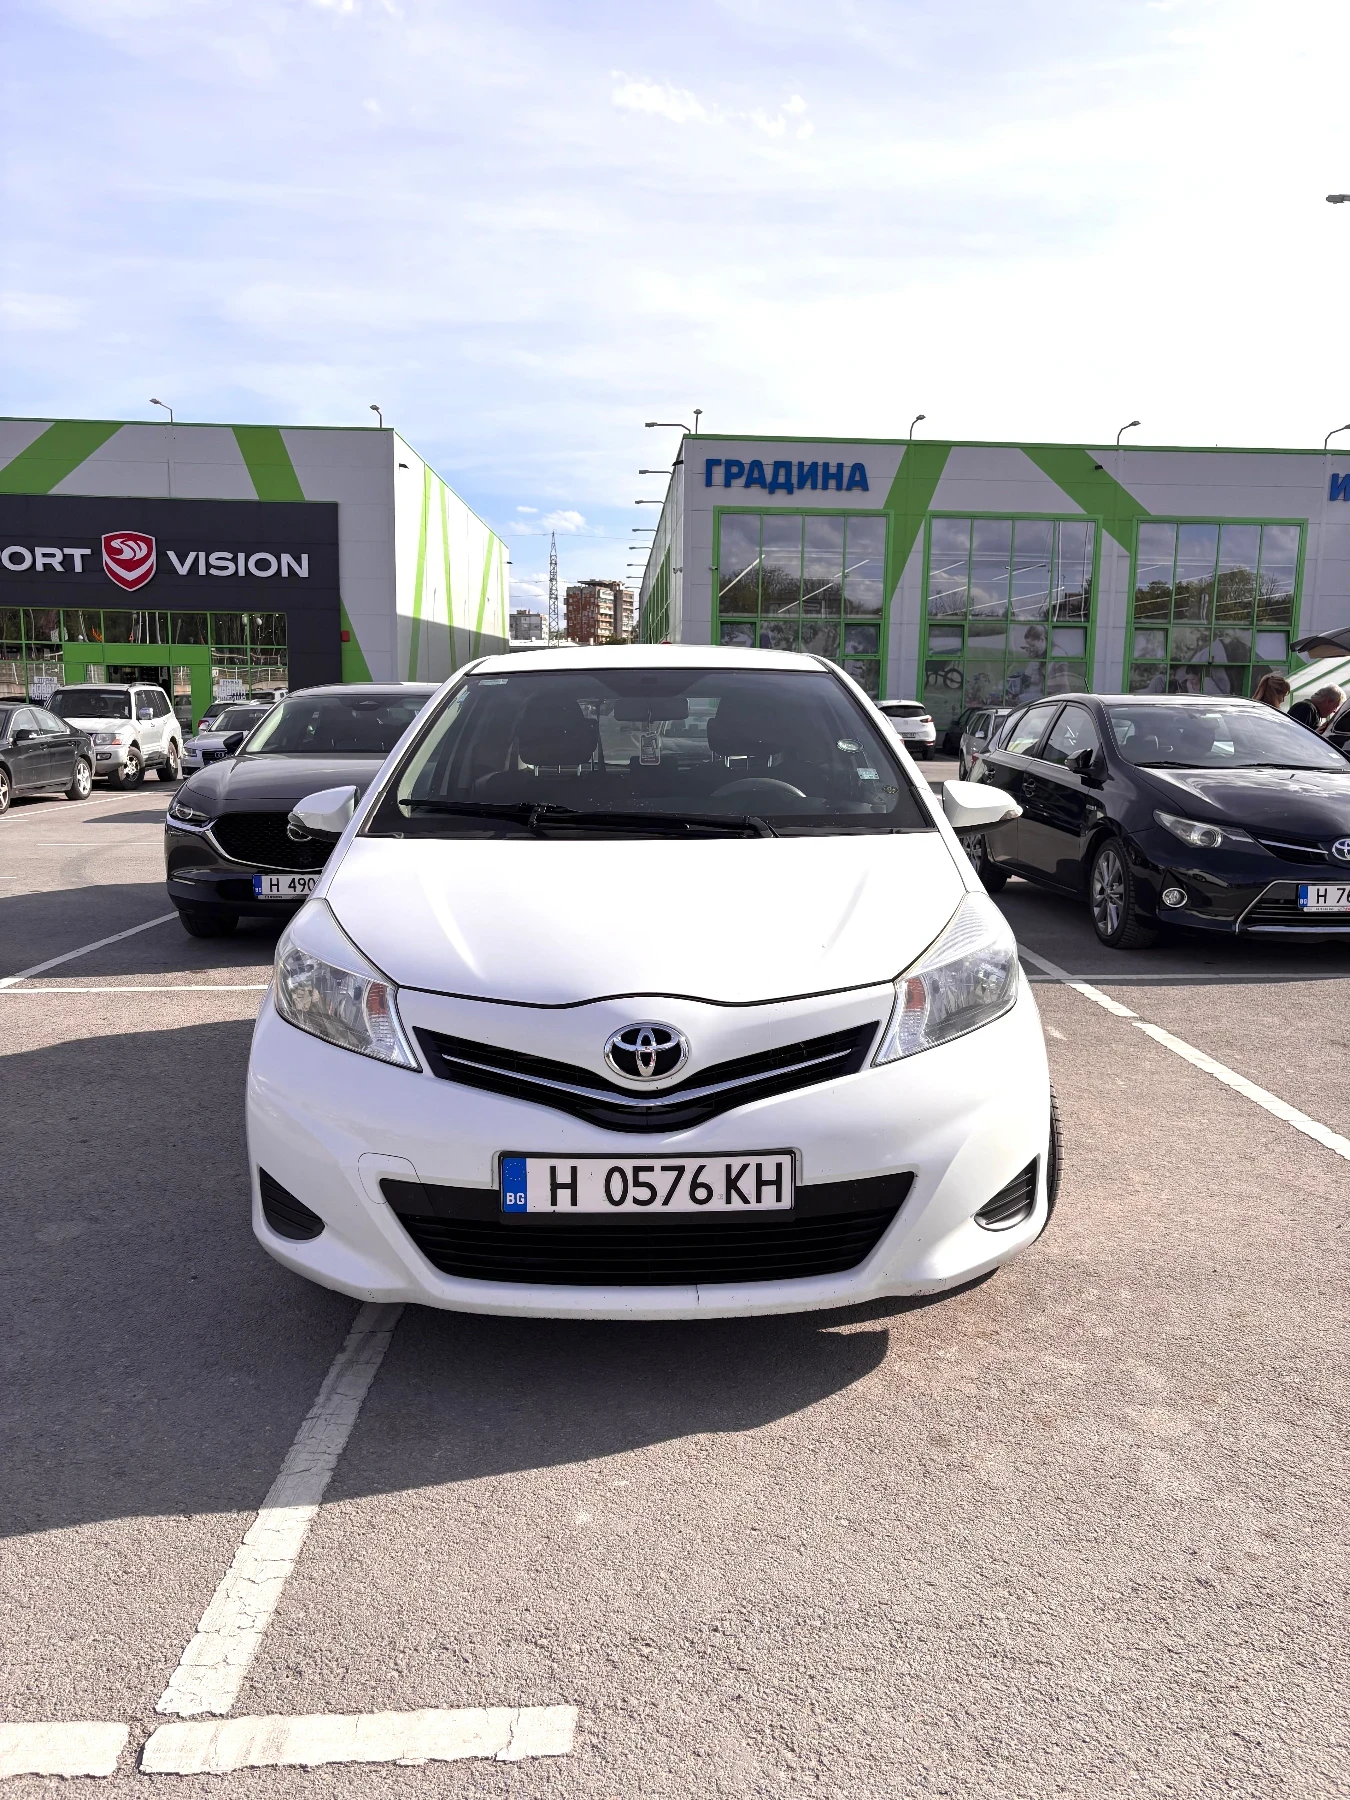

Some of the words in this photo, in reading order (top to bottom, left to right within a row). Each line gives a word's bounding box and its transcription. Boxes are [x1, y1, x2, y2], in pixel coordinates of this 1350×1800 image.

[705, 459, 869, 495] ГРАДИНА
[0, 545, 92, 572] ORT
[166, 551, 309, 578] VISION
[1316, 887, 1328, 904] H
[506, 1192, 525, 1205] BG
[549, 1165, 578, 1206] H
